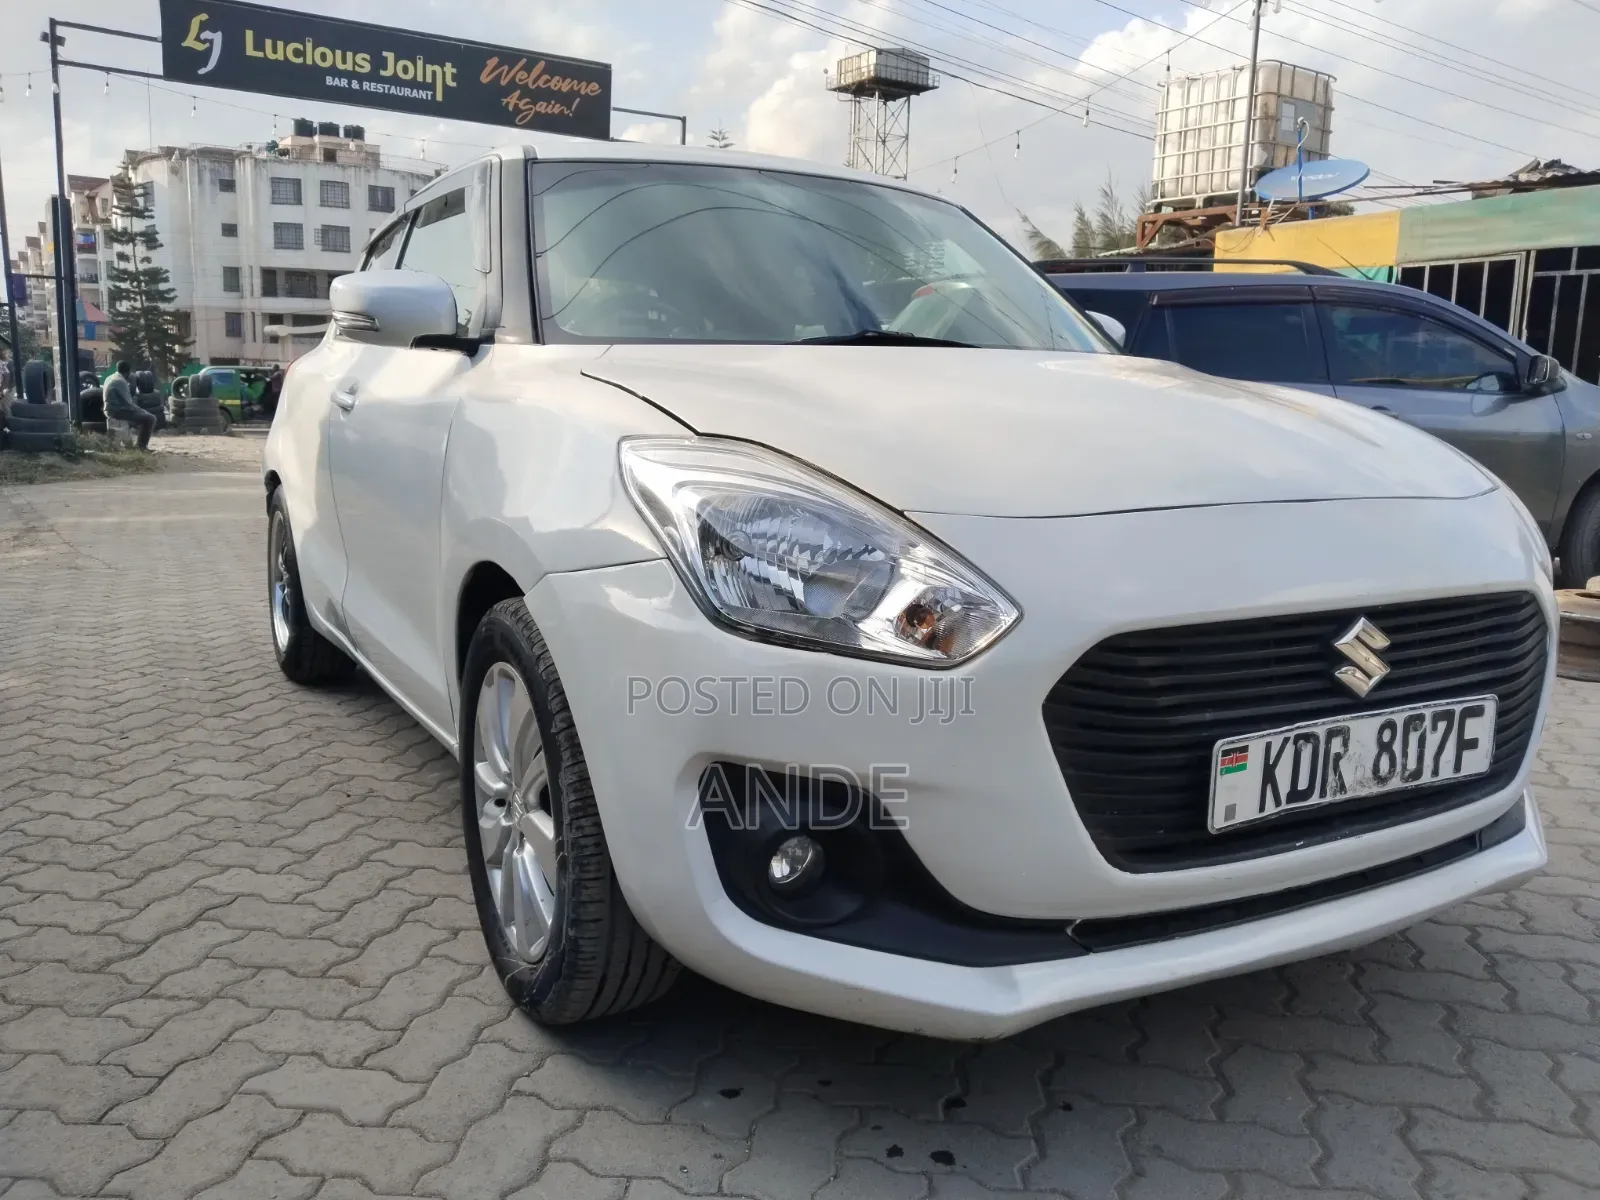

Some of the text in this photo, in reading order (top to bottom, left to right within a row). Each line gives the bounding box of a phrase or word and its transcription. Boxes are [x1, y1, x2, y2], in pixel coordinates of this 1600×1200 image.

[245, 29, 457, 101] Lucious Joint
[480, 56, 602, 96] Welcome
[325, 75, 433, 101] BAR & RESTAURANT
[501, 89, 580, 125] Again!
[1258, 724, 1350, 813] KDR
[1372, 704, 1486, 786] 807F
